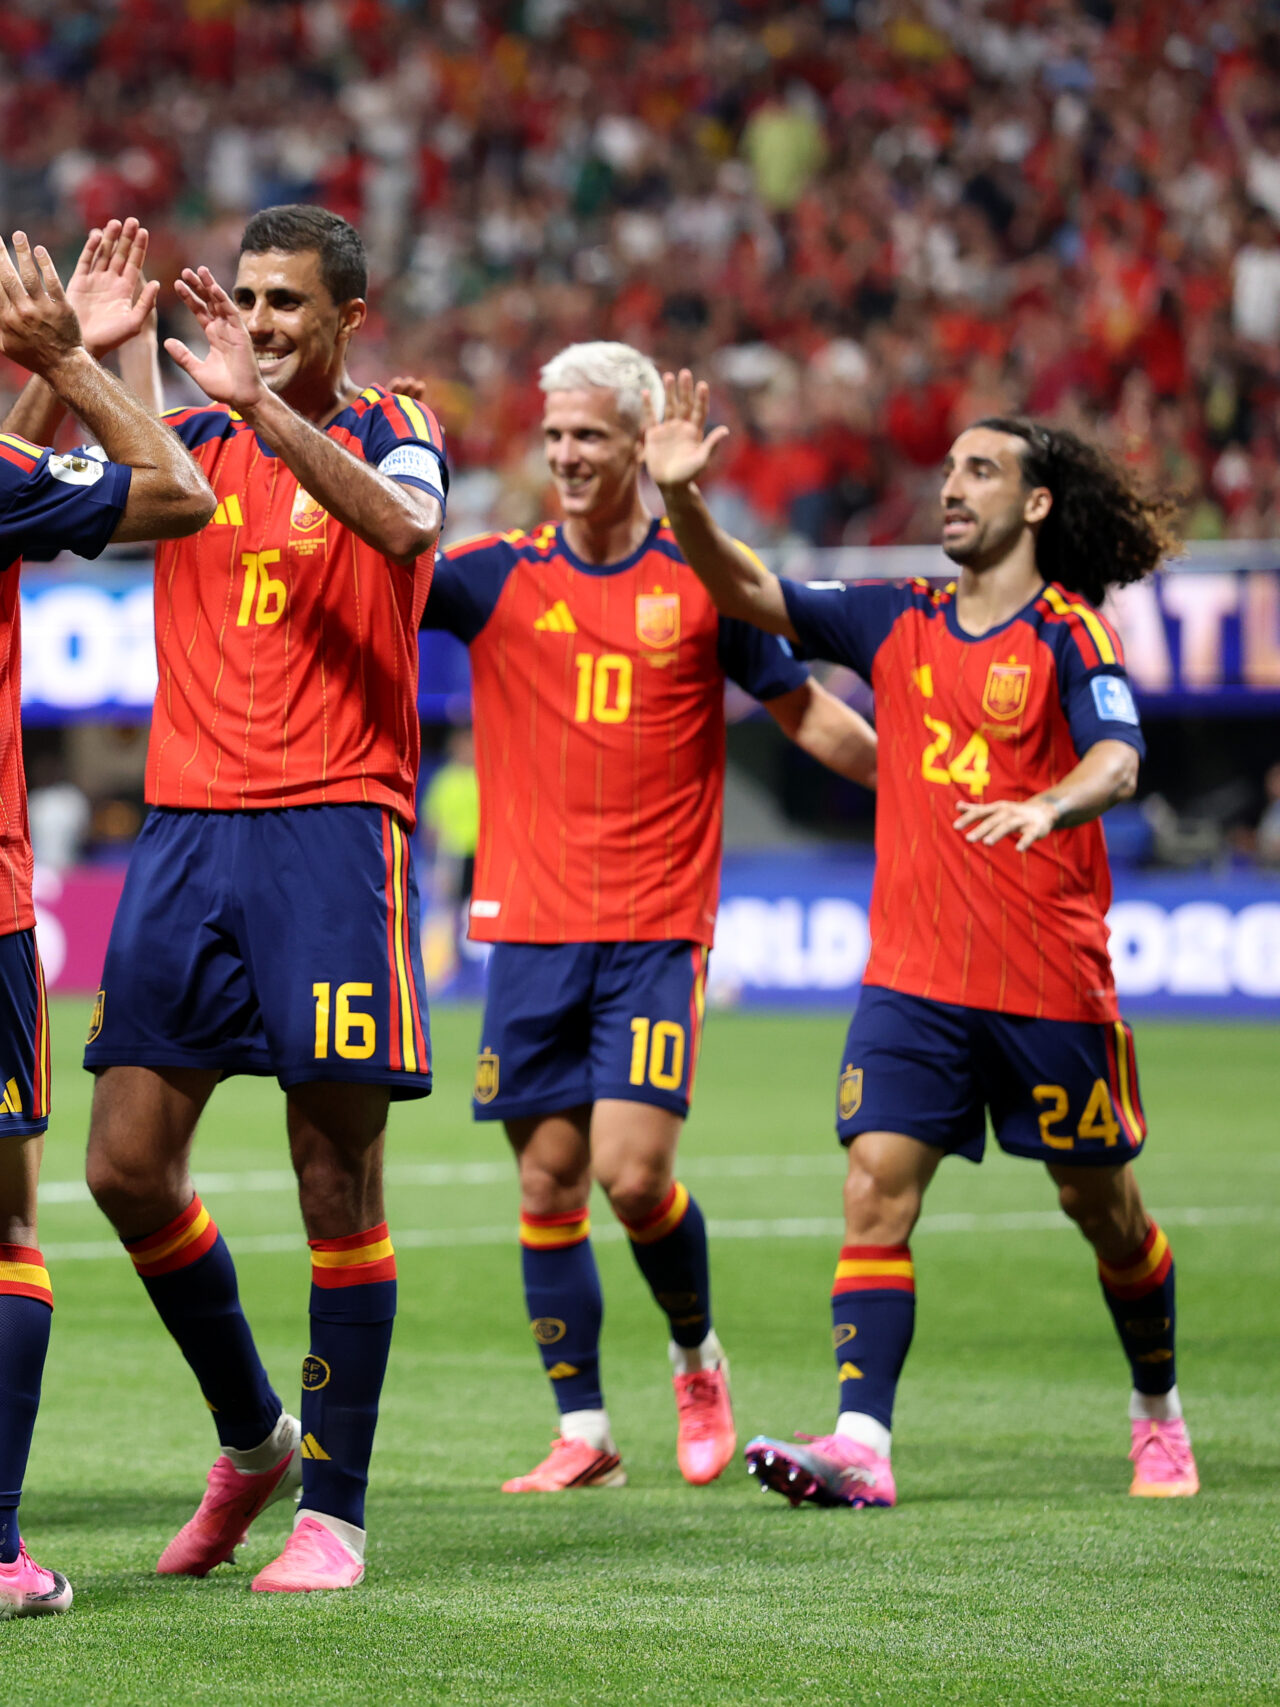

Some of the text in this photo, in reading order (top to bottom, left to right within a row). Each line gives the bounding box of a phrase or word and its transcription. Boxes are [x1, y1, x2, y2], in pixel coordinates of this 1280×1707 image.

[236, 548, 287, 627] 16
[575, 652, 633, 724] 10
[921, 712, 991, 796] 24
[312, 981, 376, 1060] 16
[629, 1017, 685, 1090] 10
[1032, 1079, 1120, 1150] 24
